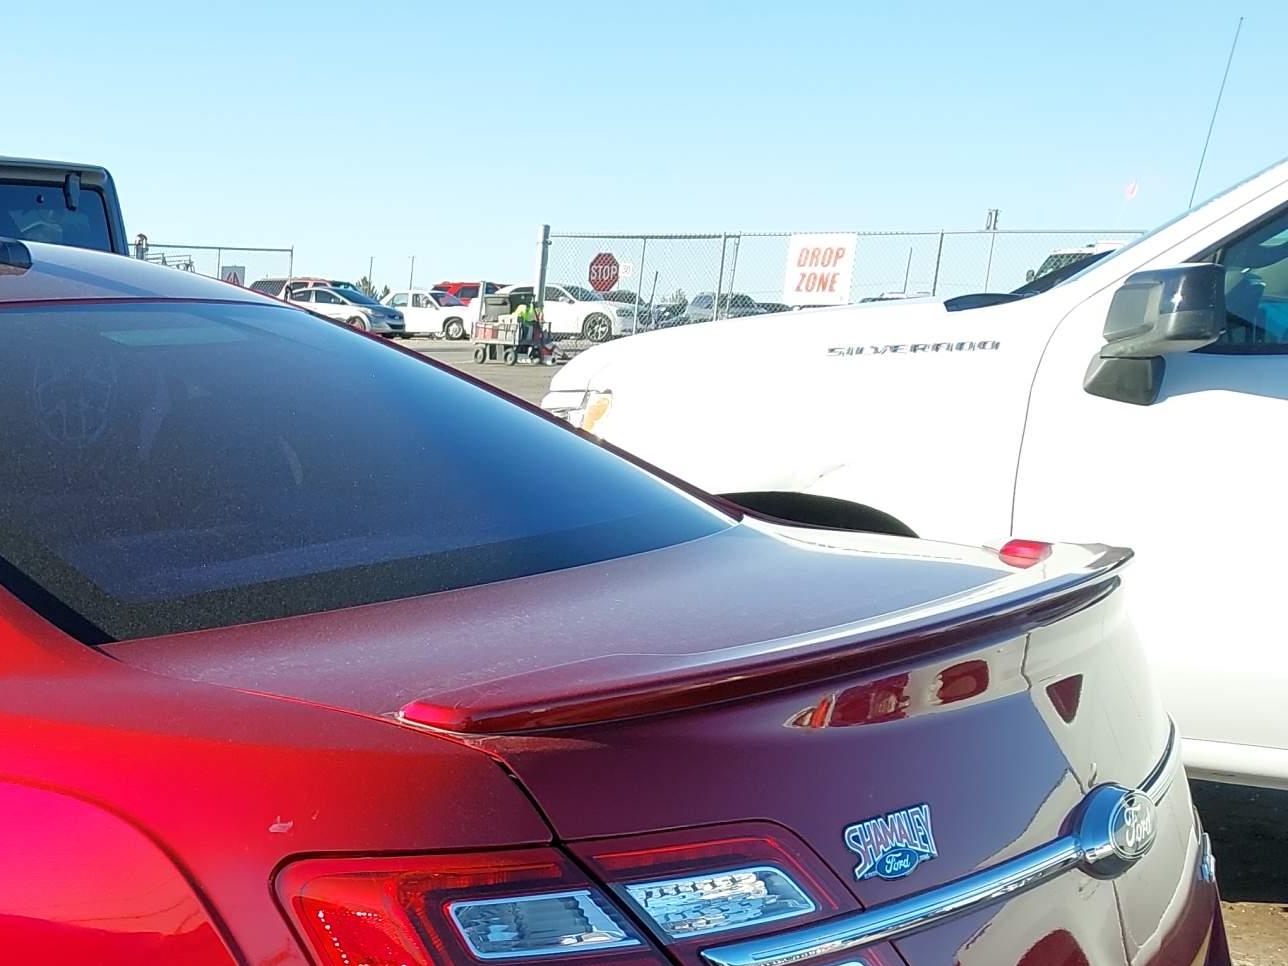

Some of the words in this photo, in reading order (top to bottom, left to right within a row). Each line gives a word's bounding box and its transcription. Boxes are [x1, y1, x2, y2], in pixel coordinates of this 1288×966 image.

[796, 247, 846, 268] DROP
[591, 265, 618, 281] STOP
[795, 271, 840, 293] ZONE
[1123, 801, 1153, 848] Ford
[844, 804, 938, 880] SHAMALEY
[885, 852, 911, 874] Ford
